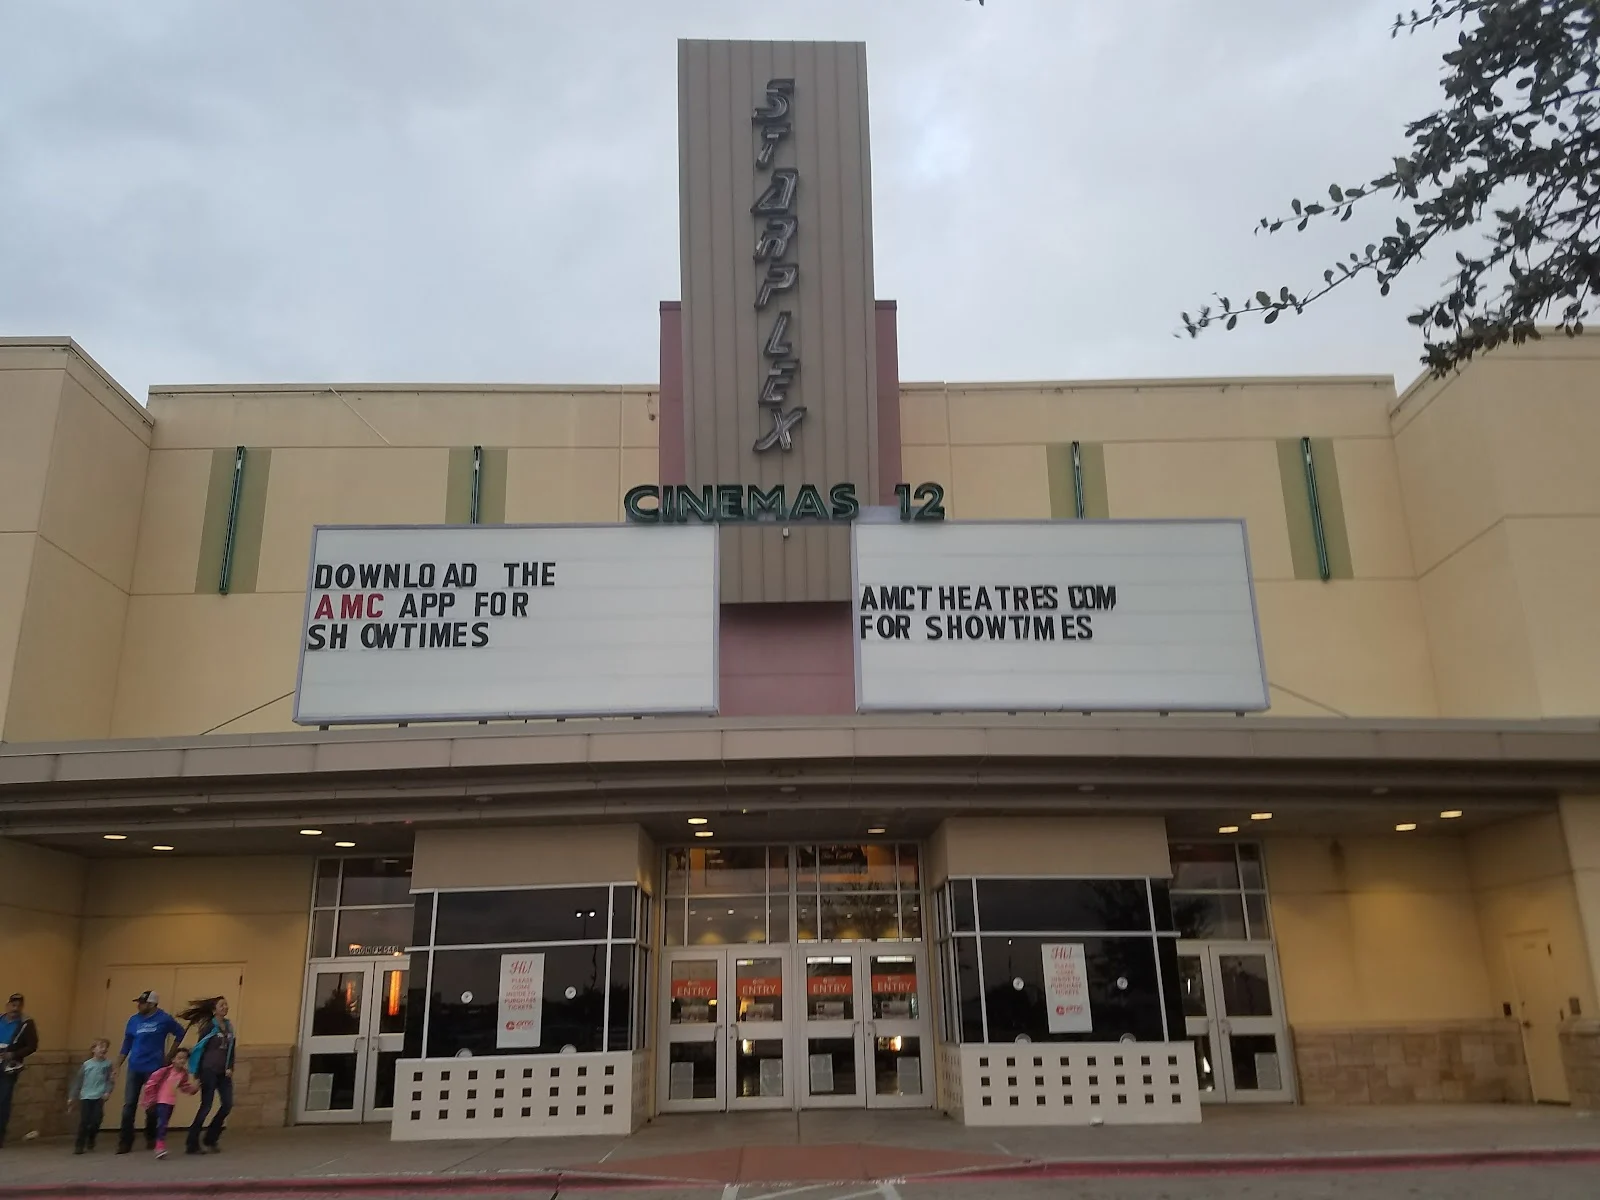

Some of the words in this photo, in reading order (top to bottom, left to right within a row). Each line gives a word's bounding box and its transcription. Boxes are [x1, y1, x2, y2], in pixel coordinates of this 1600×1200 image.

[750, 78, 807, 452] STARPLEX
[624, 483, 860, 523] CINEMAS
[894, 482, 946, 522] 12
[503, 561, 556, 588] THE
[313, 592, 385, 620] AMC
[398, 591, 456, 618] APP
[474, 591, 529, 618] FOR
[859, 614, 911, 640] FOR
[924, 613, 1093, 641] SHOWTIMES
[676, 986, 712, 996] ENTRY
[742, 984, 776, 995] ENTRY
[813, 983, 847, 993] ENTRY
[877, 982, 911, 993] ENTRY
